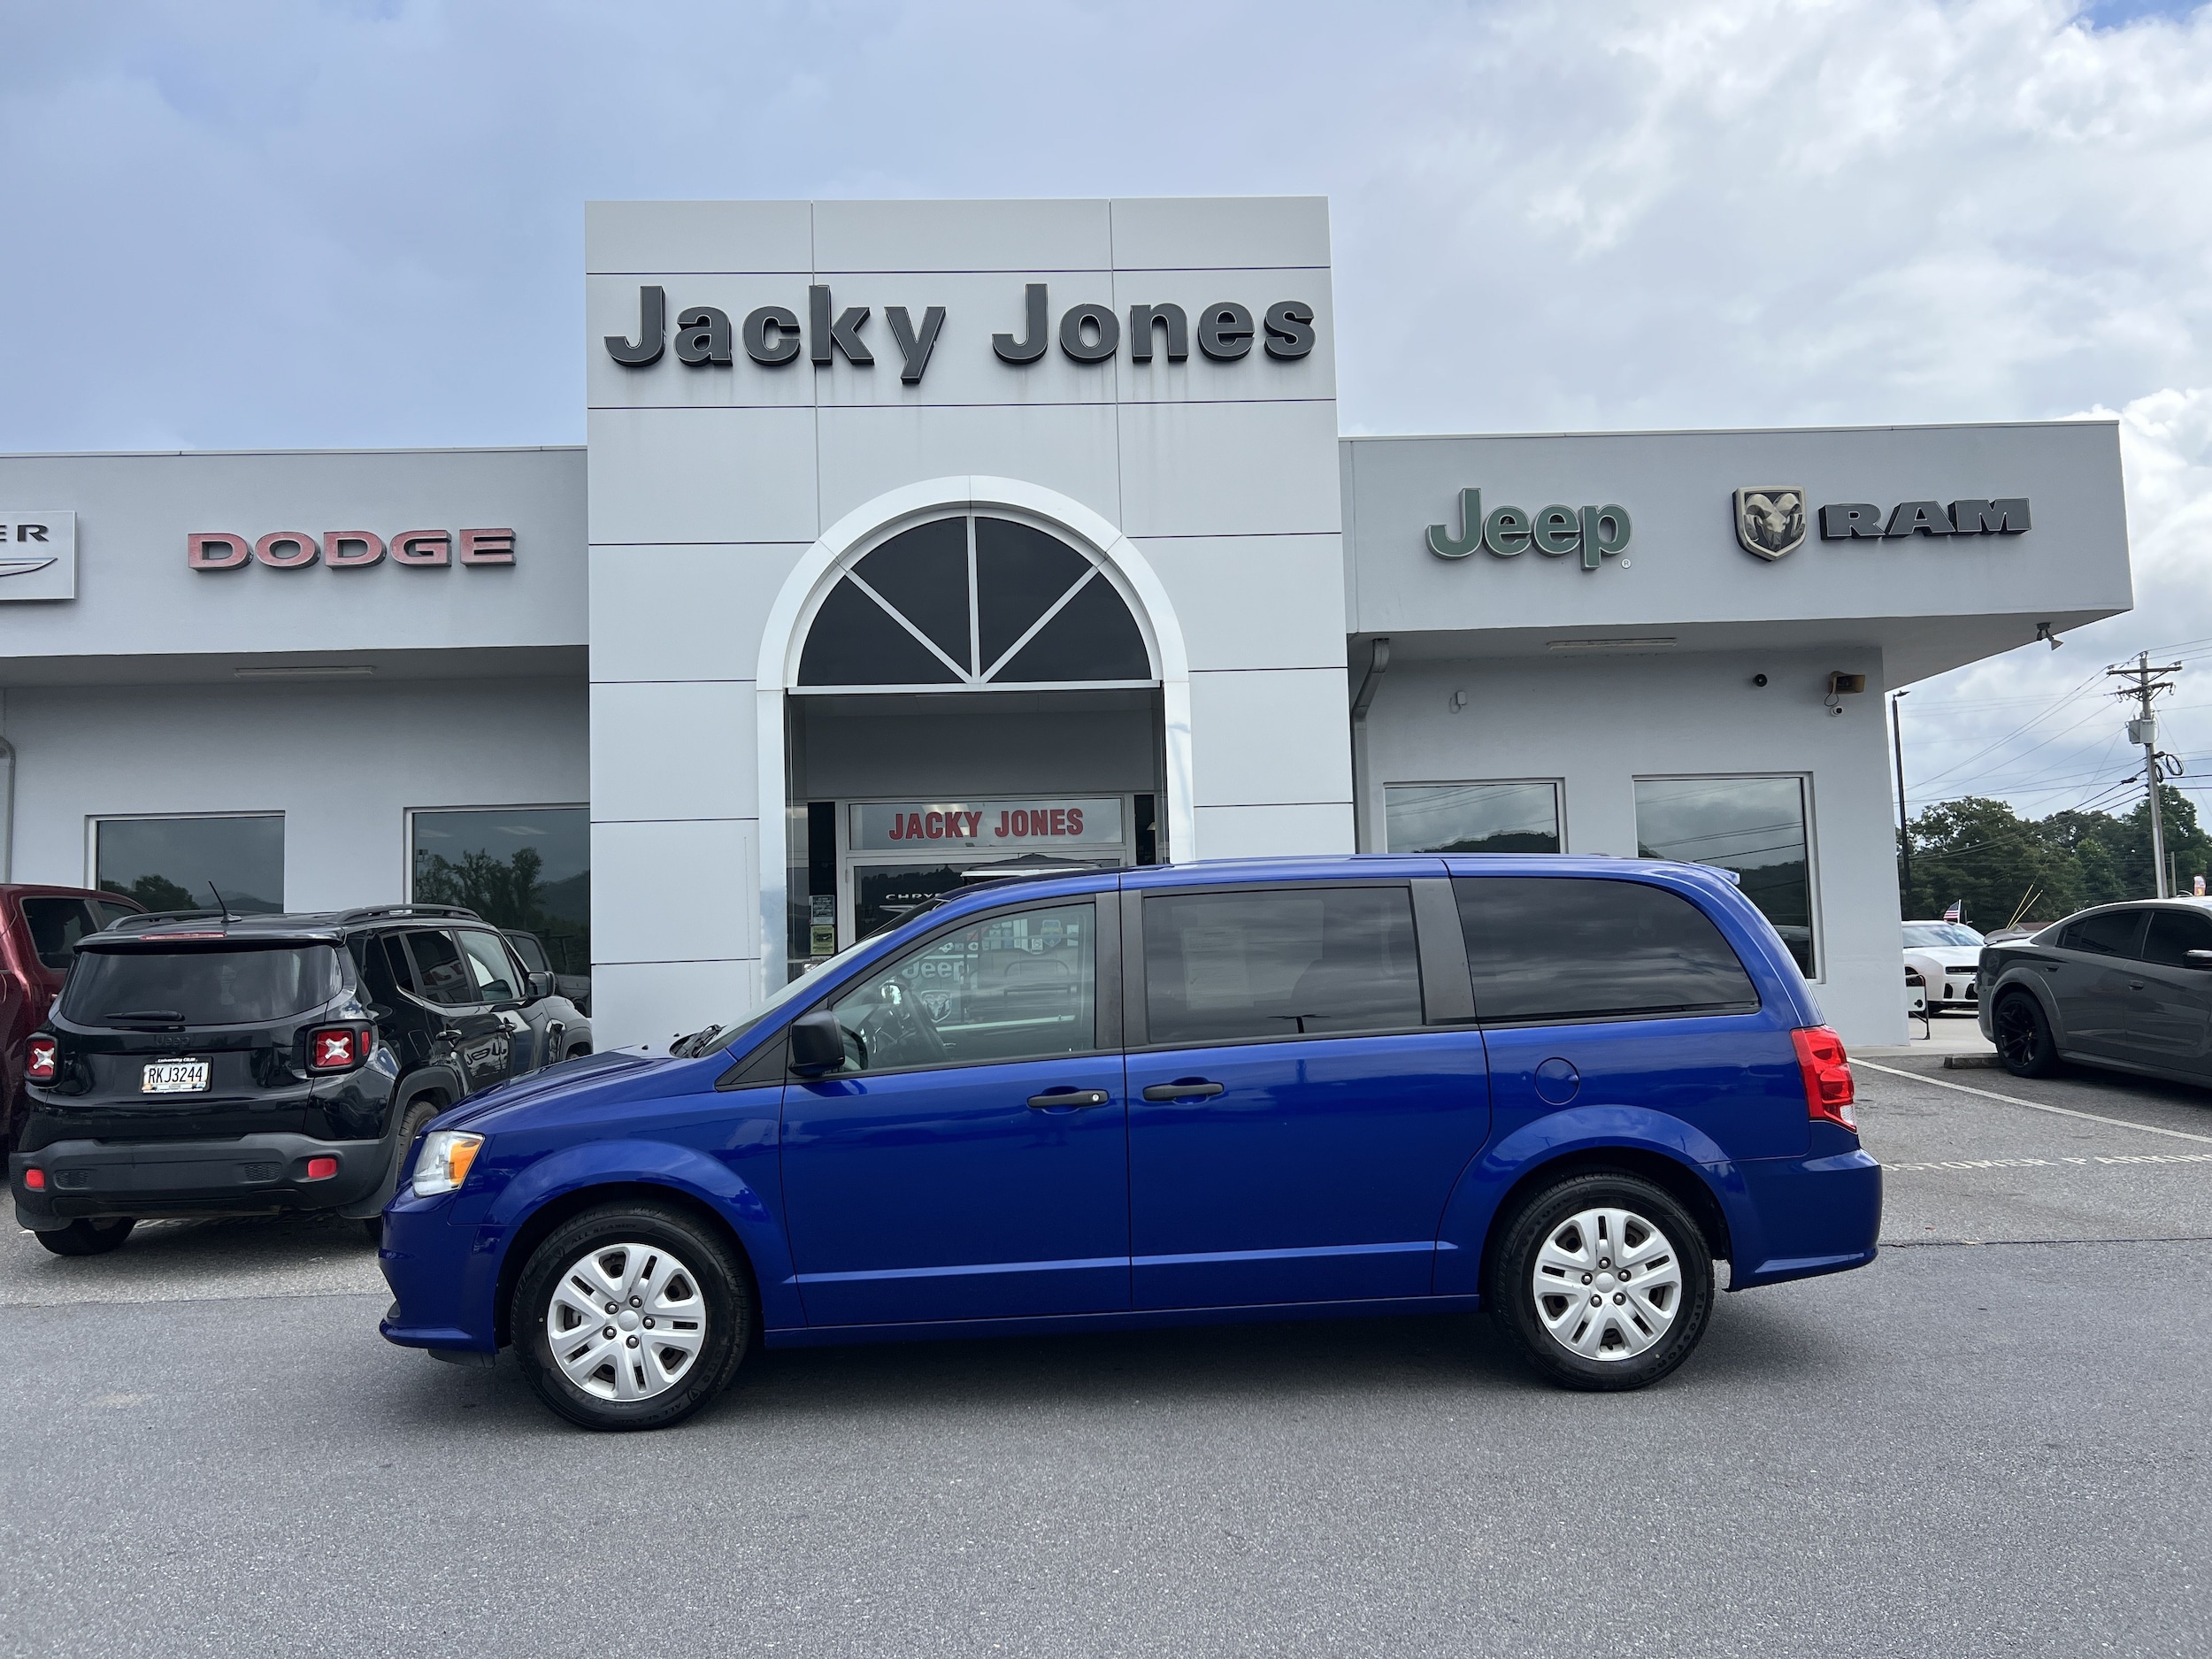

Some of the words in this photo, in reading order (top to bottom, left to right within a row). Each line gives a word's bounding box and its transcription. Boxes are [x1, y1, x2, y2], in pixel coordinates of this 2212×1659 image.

[603, 285, 947, 385] Jacky
[992, 284, 1317, 365] Jones
[0, 524, 49, 541] R
[1425, 488, 1633, 571] Jeep
[1818, 497, 2032, 540] RAM
[188, 528, 516, 572] DODGE
[888, 811, 983, 840] JACKY
[995, 808, 1084, 837] JONES
[157, 1033, 190, 1047] Jeep
[148, 1066, 203, 1084] RKJ3244
[2061, 1155, 2212, 1165] PARKIN
